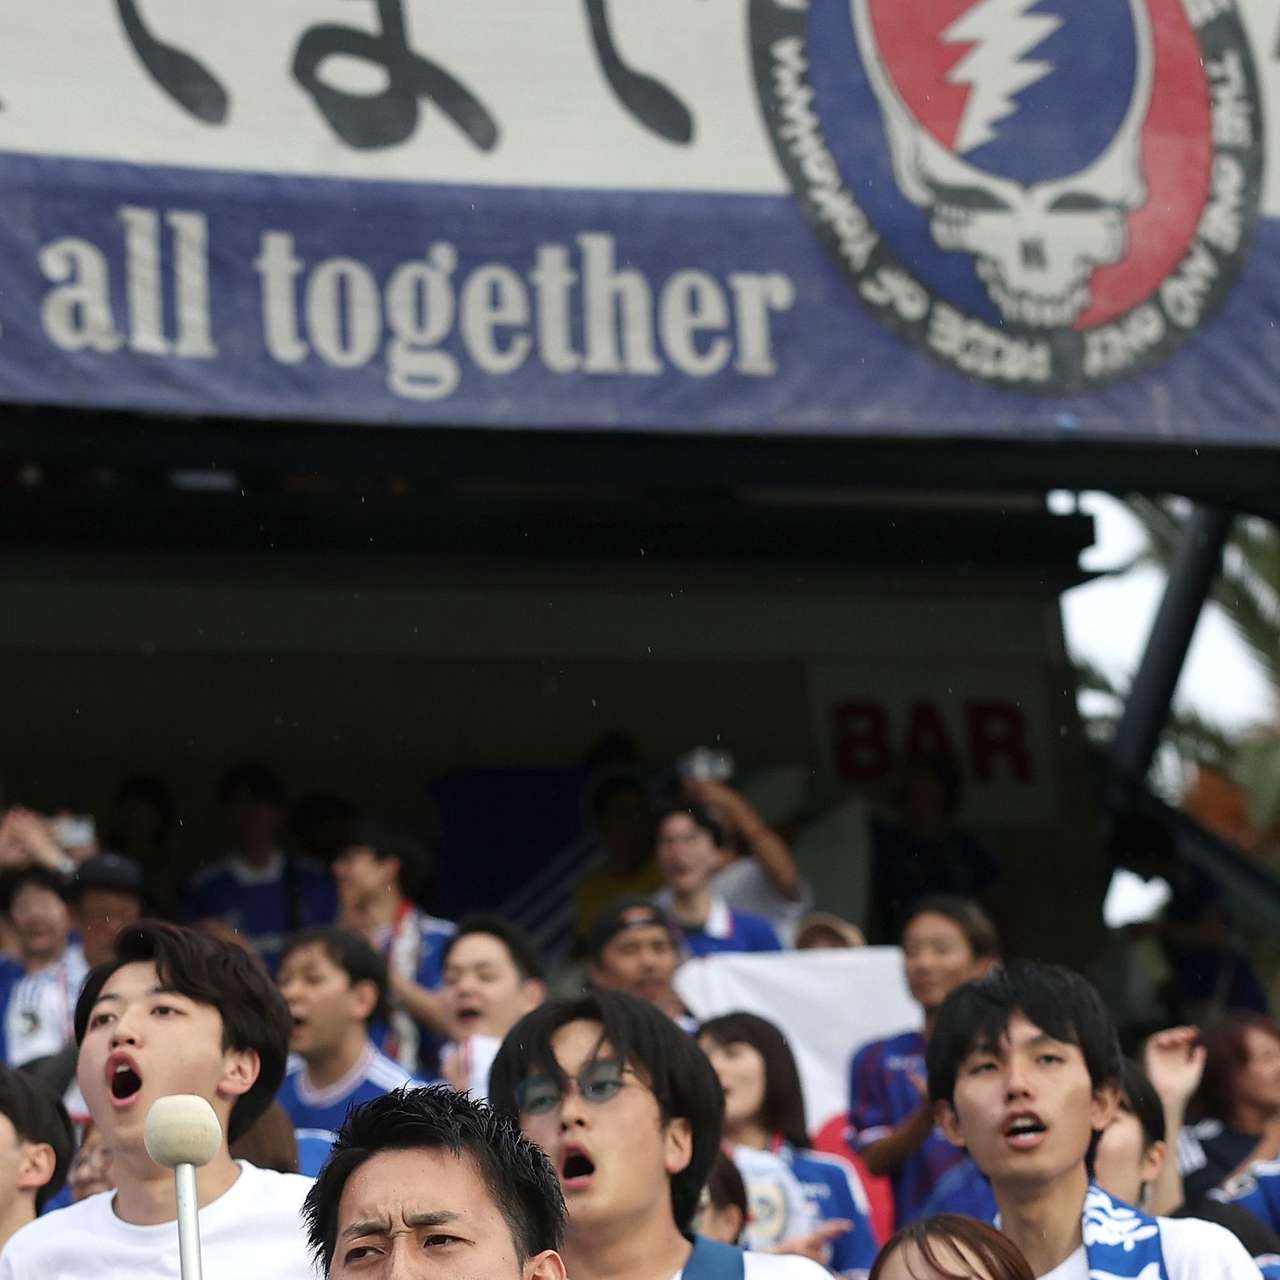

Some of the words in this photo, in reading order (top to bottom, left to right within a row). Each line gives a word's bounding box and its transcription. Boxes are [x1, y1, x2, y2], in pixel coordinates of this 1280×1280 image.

[39, 206, 217, 359] all
[255, 231, 794, 400] together
[833, 700, 1032, 784] BAR
